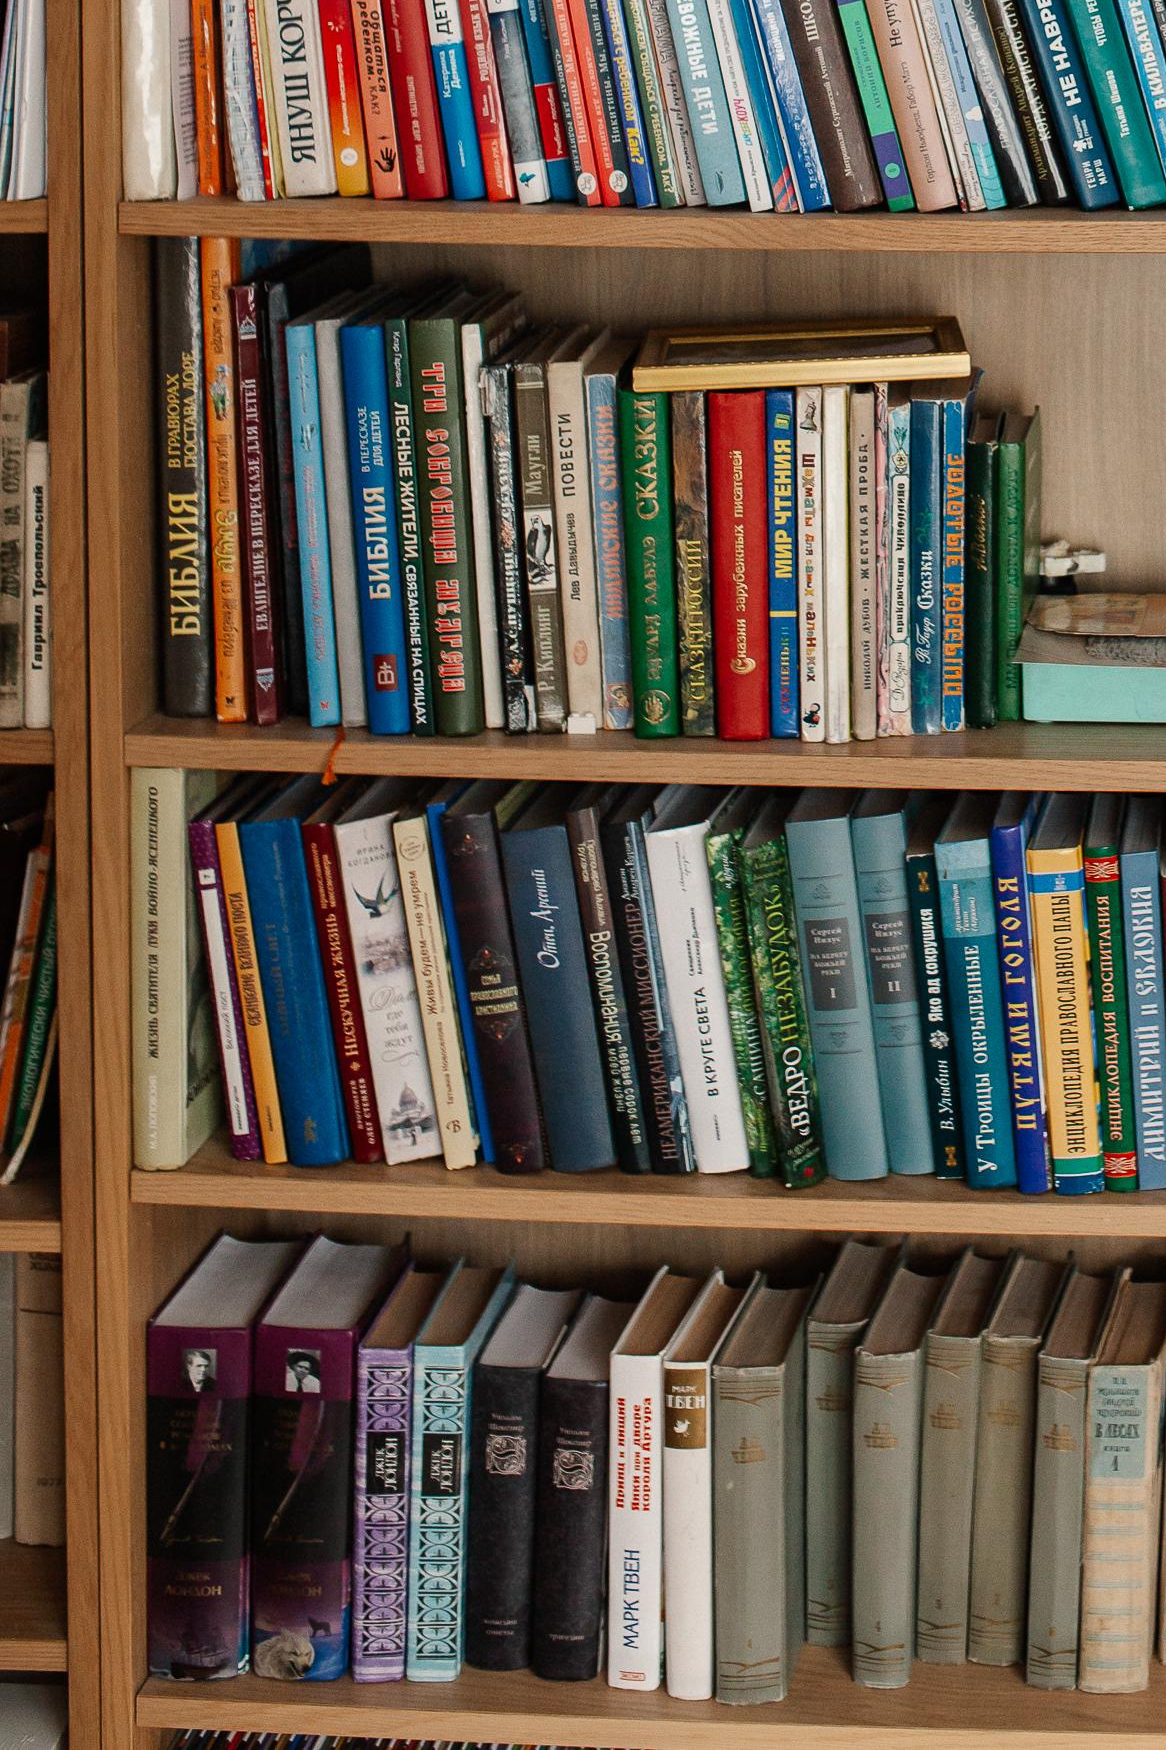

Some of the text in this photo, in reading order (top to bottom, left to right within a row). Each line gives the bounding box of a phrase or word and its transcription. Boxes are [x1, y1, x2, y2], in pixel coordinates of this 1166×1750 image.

[889, 28, 903, 47] Не
[1090, 14, 1108, 46] ЧТОБЫ
[282, 72, 316, 164] ЯНУШ
[692, 88, 719, 134] ДЕТИ
[1061, 74, 1082, 106] НЕ
[1081, 161, 1098, 189] ГЕНРИ
[1094, 158, 1108, 185] МАРШ
[166, 373, 181, 468] В ГРАВЮРАХ
[182, 350, 198, 468] ГЮСТАВА ДОРЕ
[357, 406, 370, 472] В ПЕРЕСКАЗЕ
[370, 410, 384, 467] ДЛЯ ДЕТЕЙ
[557, 413, 576, 497] ПОВЕСТИ
[634, 399, 660, 520] СКАЗКИ
[524, 434, 546, 495] Маугли
[773, 439, 793, 579] МИР ЧТЕНИЯ
[858, 443, 870, 580] ЖЕСТКАЯ ПРОБА
[31, 485, 46, 671] Гавриил Троепольский
[168, 492, 202, 636] БИБЛИЯ
[363, 486, 392, 600] БИБЛИЯ
[394, 402, 429, 724] ЛЕСНЫЕ ЖИТЕЛИ, СВЯЗАННЫЕ НА СПИЦАХ
[565, 512, 581, 601] Лев Давыдычев
[729, 450, 757, 674] Сказки зарубежных писателей
[915, 550, 935, 610] Сказки
[534, 604, 556, 691] Р. Киплинг
[146, 786, 159, 1059] ЖИЗНЬ СВЯТИТЕЛЯ ЛУКИ ВОЙНО-ЯСЕНЕЦКОГО
[530, 868, 559, 922] Арсений
[1050, 894, 1072, 933] ПАПЫ
[763, 883, 799, 1042] НЕЗАБУДОК»
[918, 908, 943, 1022] Яко ад сокрушися
[998, 875, 1040, 1130] ПУТЯМИ ГОГОЛЯ
[1053, 936, 1081, 1044] ПРАВОСЛАВНОГО
[624, 903, 679, 1160] НЕАМЕРИКАНСКИЙ МИССИОНЕР
[693, 986, 719, 1097] В КРУГЕ СВЕТА
[1096, 895, 1124, 1141] ЭНЦИКЛОПЕДИЯ ВОСПИТАНИЯ
[783, 1046, 811, 1136] «ВЕДРО
[1061, 1048, 1087, 1154] ЭНЦИКЛОПЕДИЯ
[615, 1397, 626, 1509] Принц и нищий
[641, 1397, 653, 1512] короля Артура
[665, 1394, 706, 1410] ТВЕН
[630, 1404, 643, 1512] Янки при дворе
[623, 1549, 641, 1650] МАРК ТВЕН
